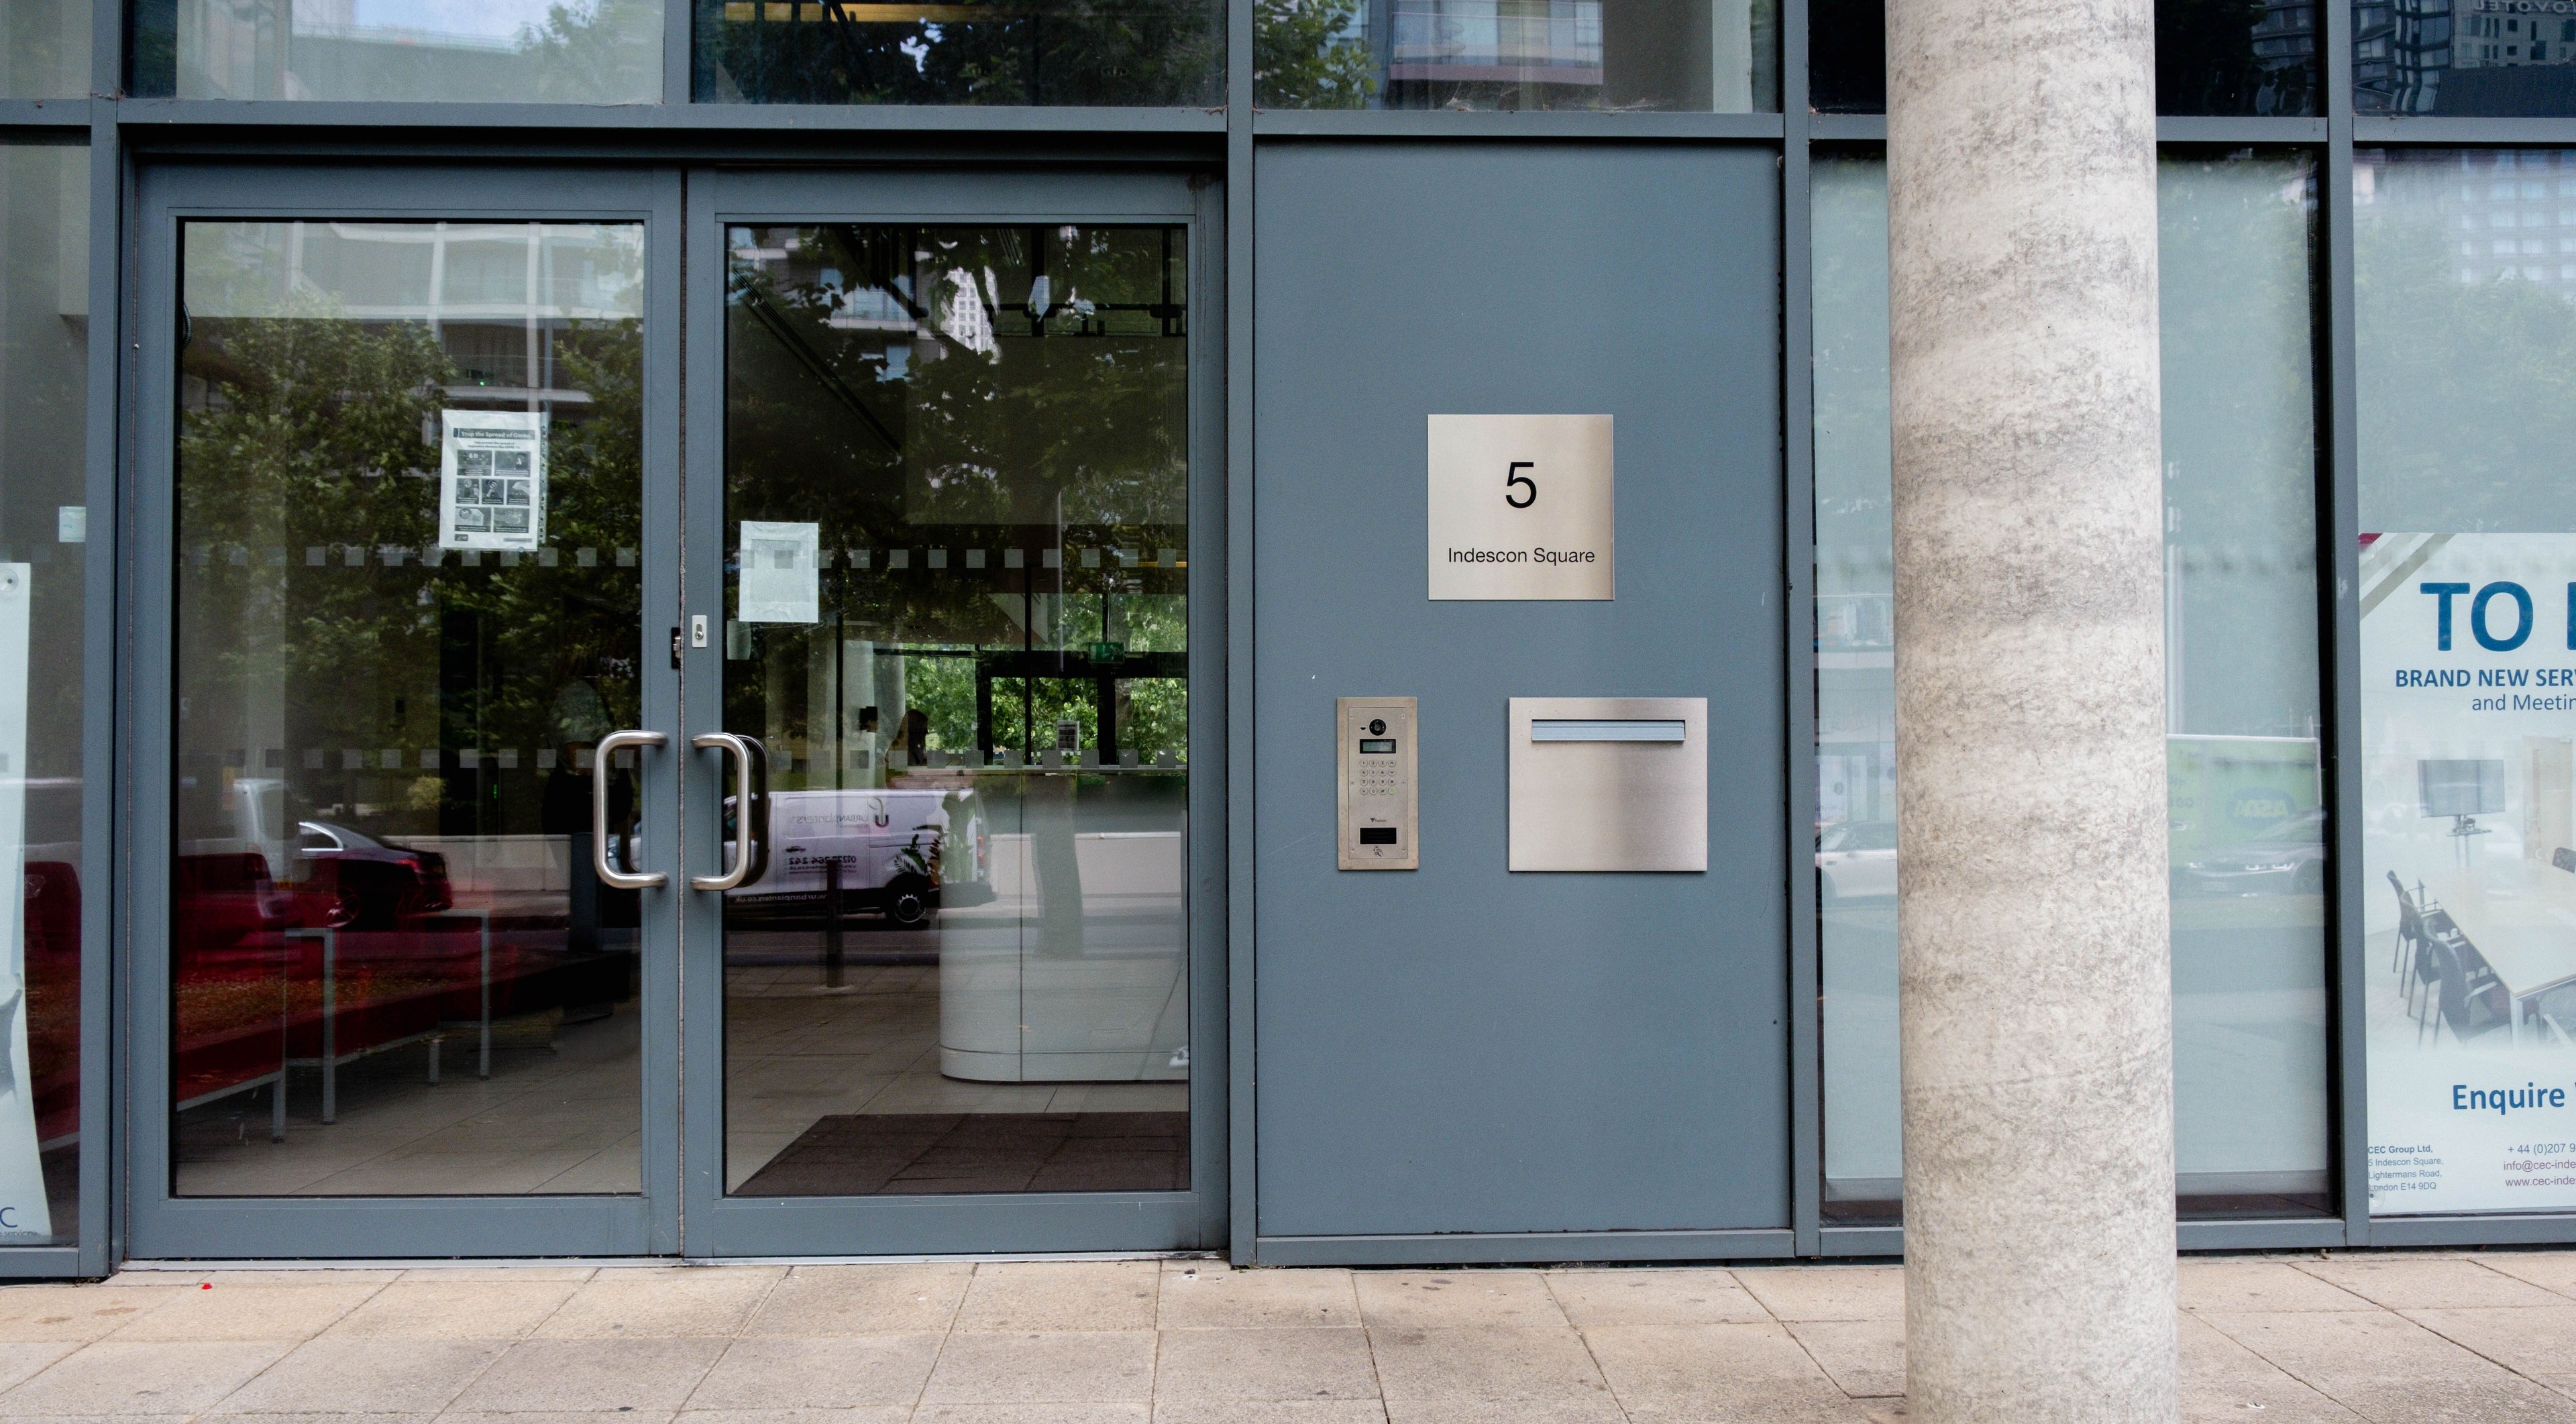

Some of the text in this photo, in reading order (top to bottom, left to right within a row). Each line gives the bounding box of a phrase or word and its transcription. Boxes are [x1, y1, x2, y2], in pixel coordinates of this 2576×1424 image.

[1505, 461, 1537, 508] 5
[1448, 547, 1595, 566] Indescon Square
[2420, 581, 2534, 652] TO
[2396, 669, 2471, 687] BRAND
[2478, 669, 2530, 687] NEW
[2472, 694, 2506, 711] and
[2453, 1082, 2565, 1115] Enquire
[2388, 1146, 2414, 1154] Group
[2417, 1144, 2433, 1152] Ltd,
[2518, 1144, 2530, 1154] 44
[2534, 1143, 2566, 1156] (0)207
[2504, 1159, 2576, 1172] info@cec-inde
[2368, 1171, 2416, 1181] Lightermans
[2505, 1176, 2576, 1187] www.cec-inde
[2369, 1183, 2398, 1191] London
[2418, 1181, 2436, 1190] 9DQ
